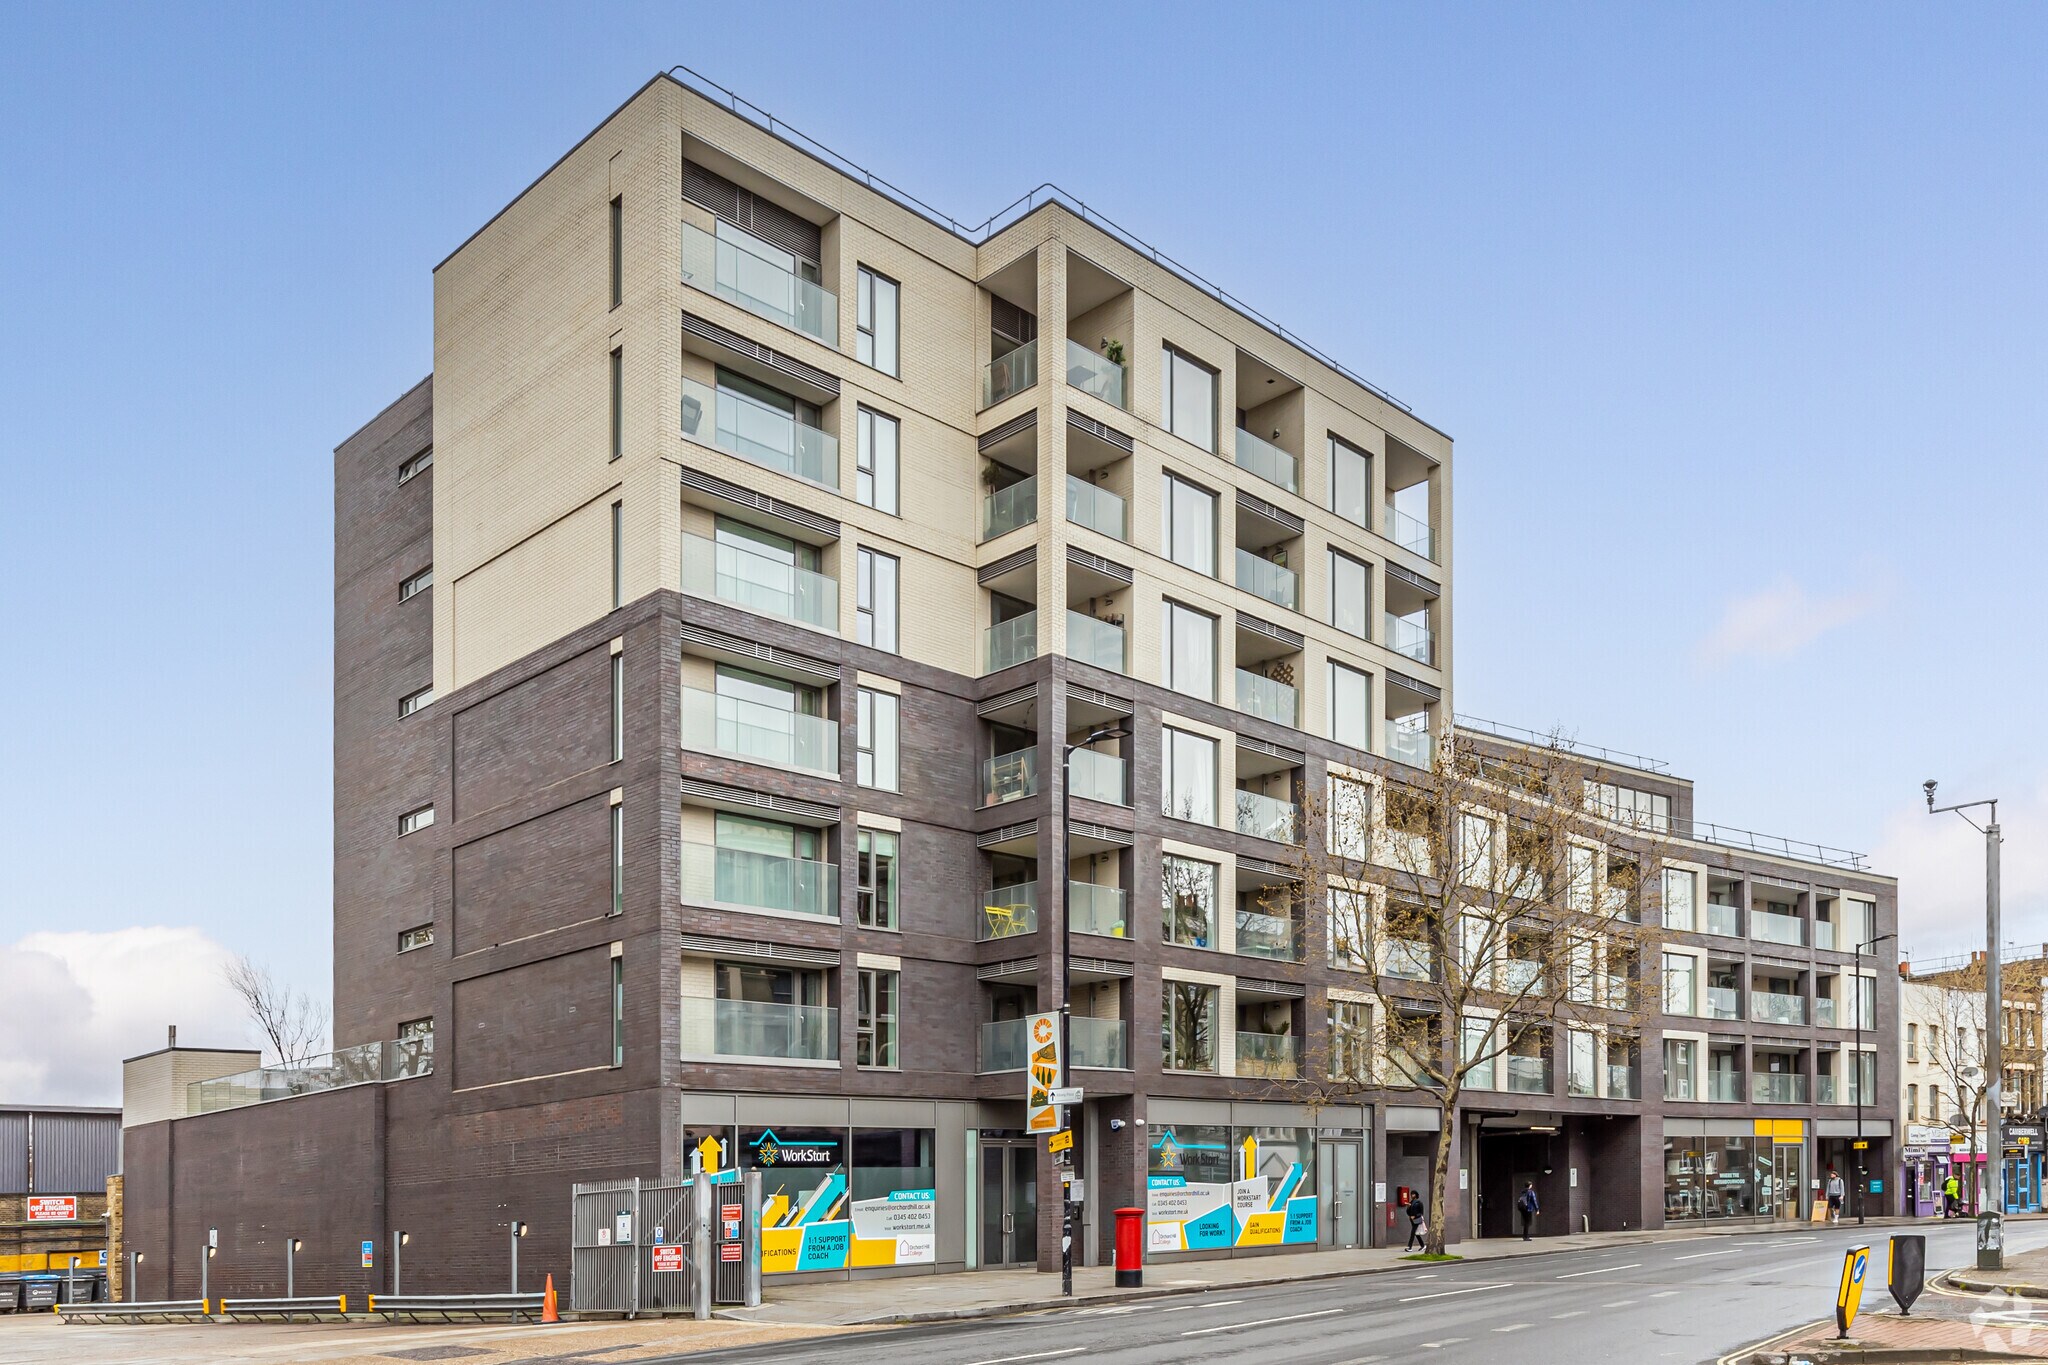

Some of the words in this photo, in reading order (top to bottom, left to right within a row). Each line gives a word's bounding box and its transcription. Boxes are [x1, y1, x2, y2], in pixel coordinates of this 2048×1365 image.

[2009, 1128, 2039, 1136] CAMBERWELL
[782, 1150, 830, 1162] WorkStart
[894, 1192, 920, 1200] CONTACT
[1250, 1227, 1281, 1235] QUALIFICATIONS
[818, 1235, 846, 1243] SUPPORT
